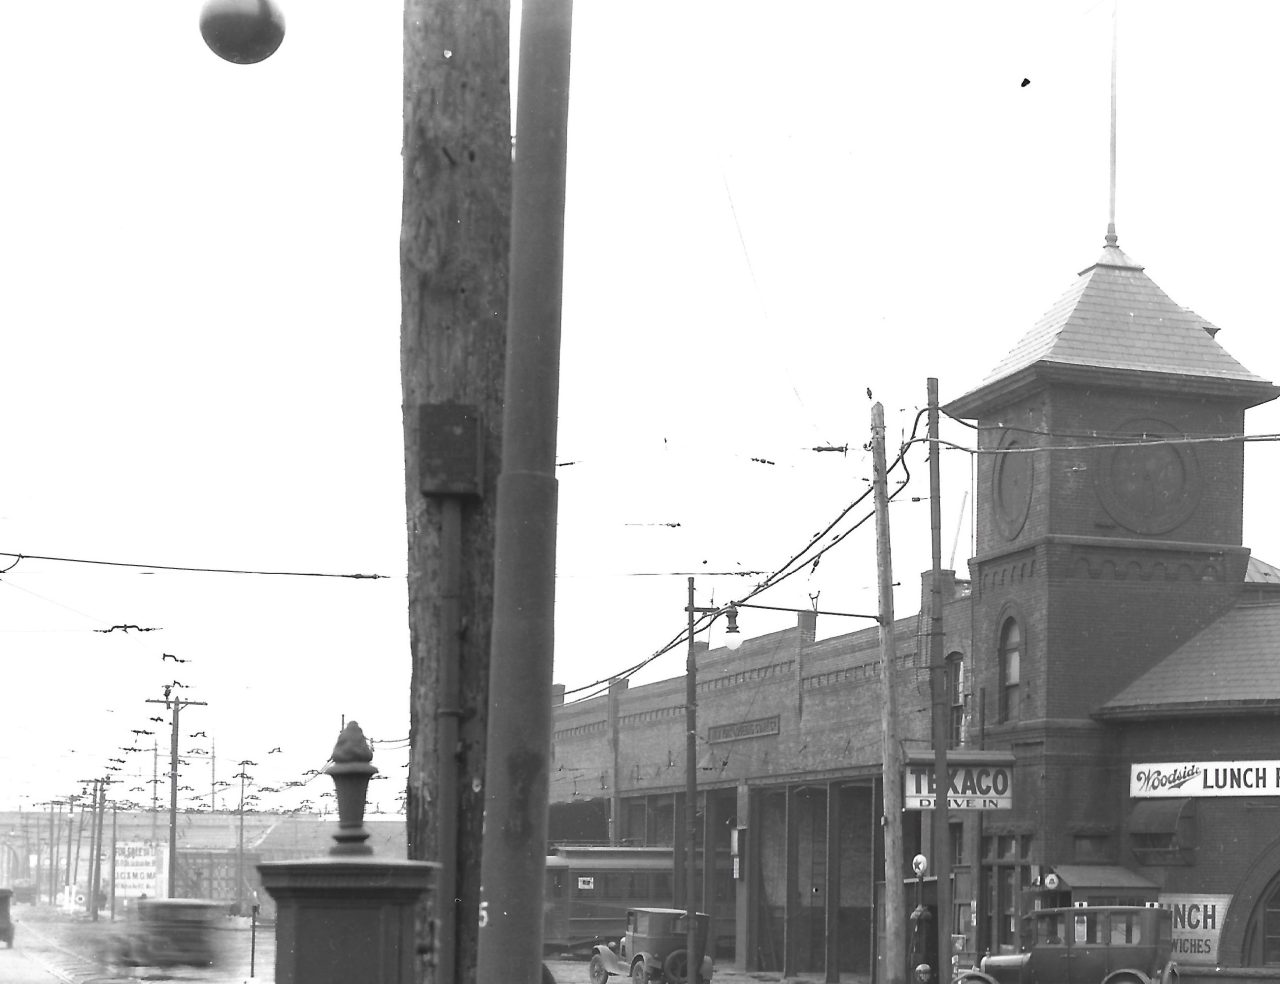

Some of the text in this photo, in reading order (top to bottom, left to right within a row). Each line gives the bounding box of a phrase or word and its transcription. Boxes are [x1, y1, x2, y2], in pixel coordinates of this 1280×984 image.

[910, 768, 1009, 795] TEXACO
[1136, 765, 1201, 792] Woodside
[1203, 768, 1267, 789] LUNCH
[920, 799, 999, 808] DIVE IN
[1160, 904, 1216, 929] NCH
